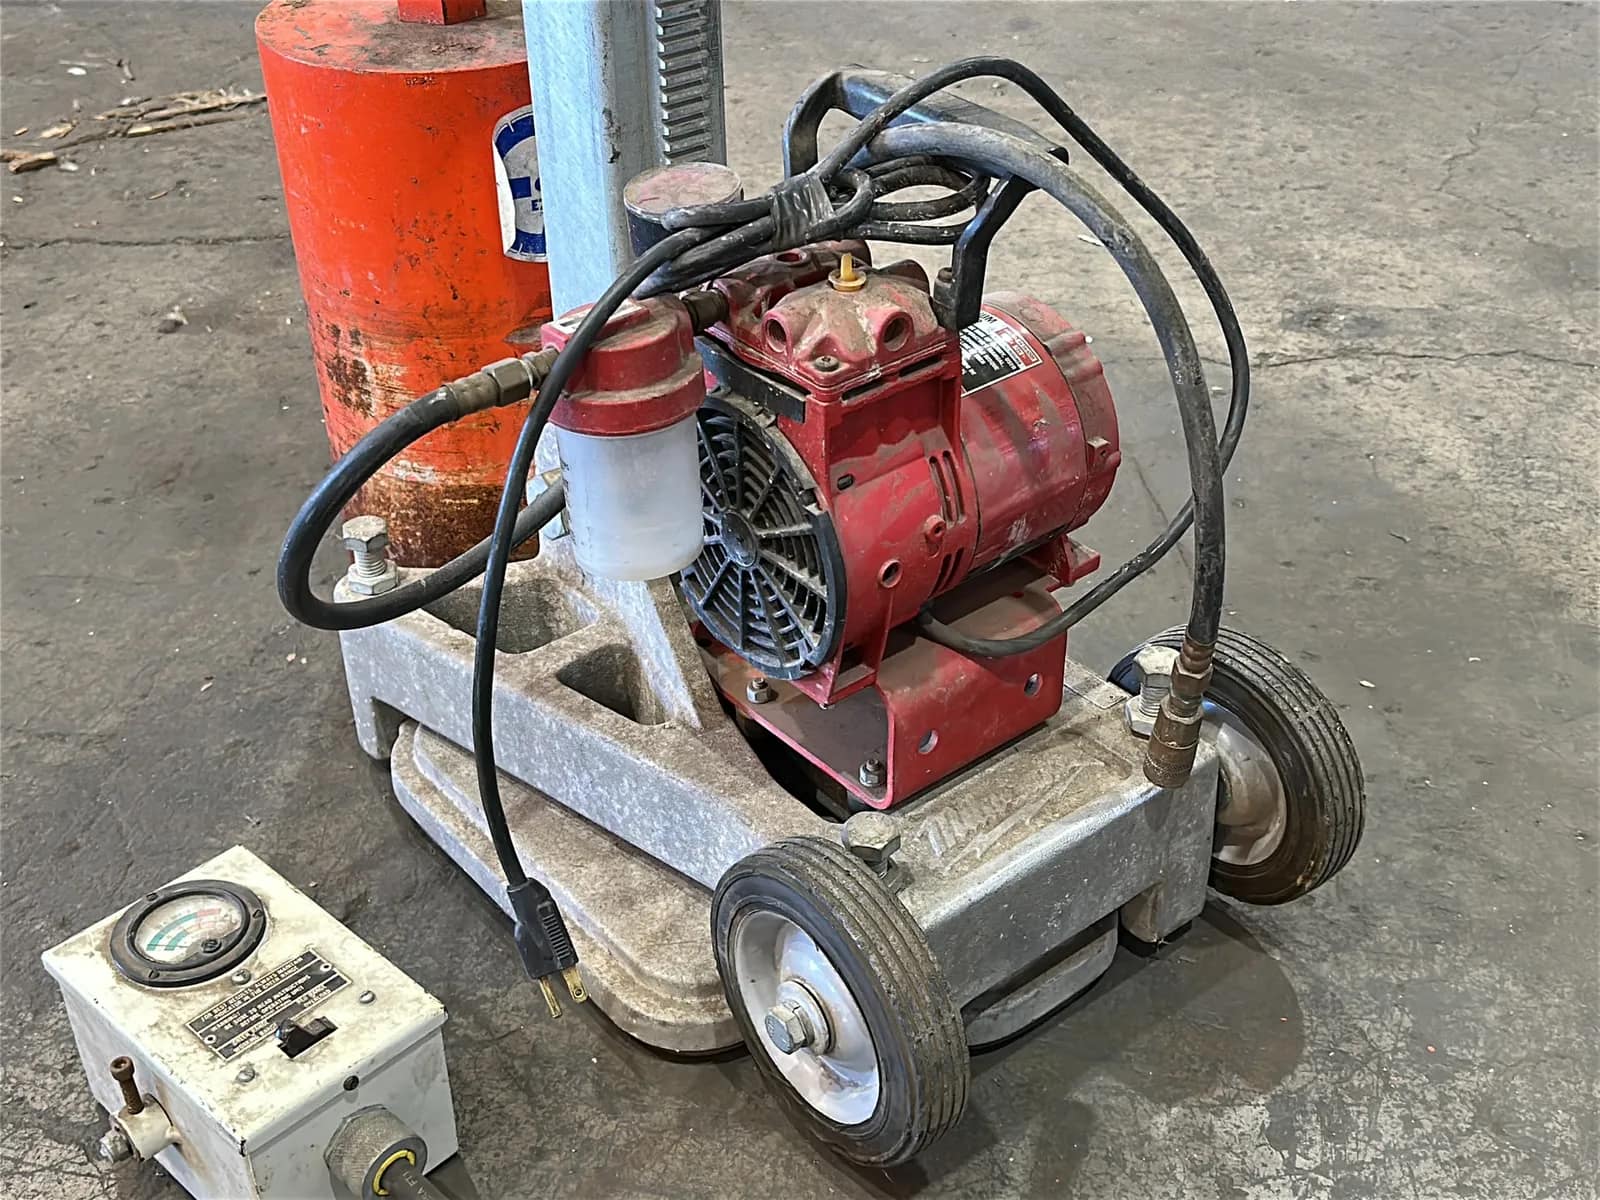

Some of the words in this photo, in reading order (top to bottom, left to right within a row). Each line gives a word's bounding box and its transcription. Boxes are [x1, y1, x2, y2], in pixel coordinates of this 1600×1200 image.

[212, 1003, 227, 1014] BEST
[255, 972, 278, 988] ALWAYS
[251, 988, 262, 996] THE
[262, 976, 281, 990] GREEN
[280, 965, 298, 979] RANGE
[257, 997, 273, 1010] READ
[272, 974, 311, 1000] INSTRUCTIONS
[260, 993, 292, 1014] OPERATING
